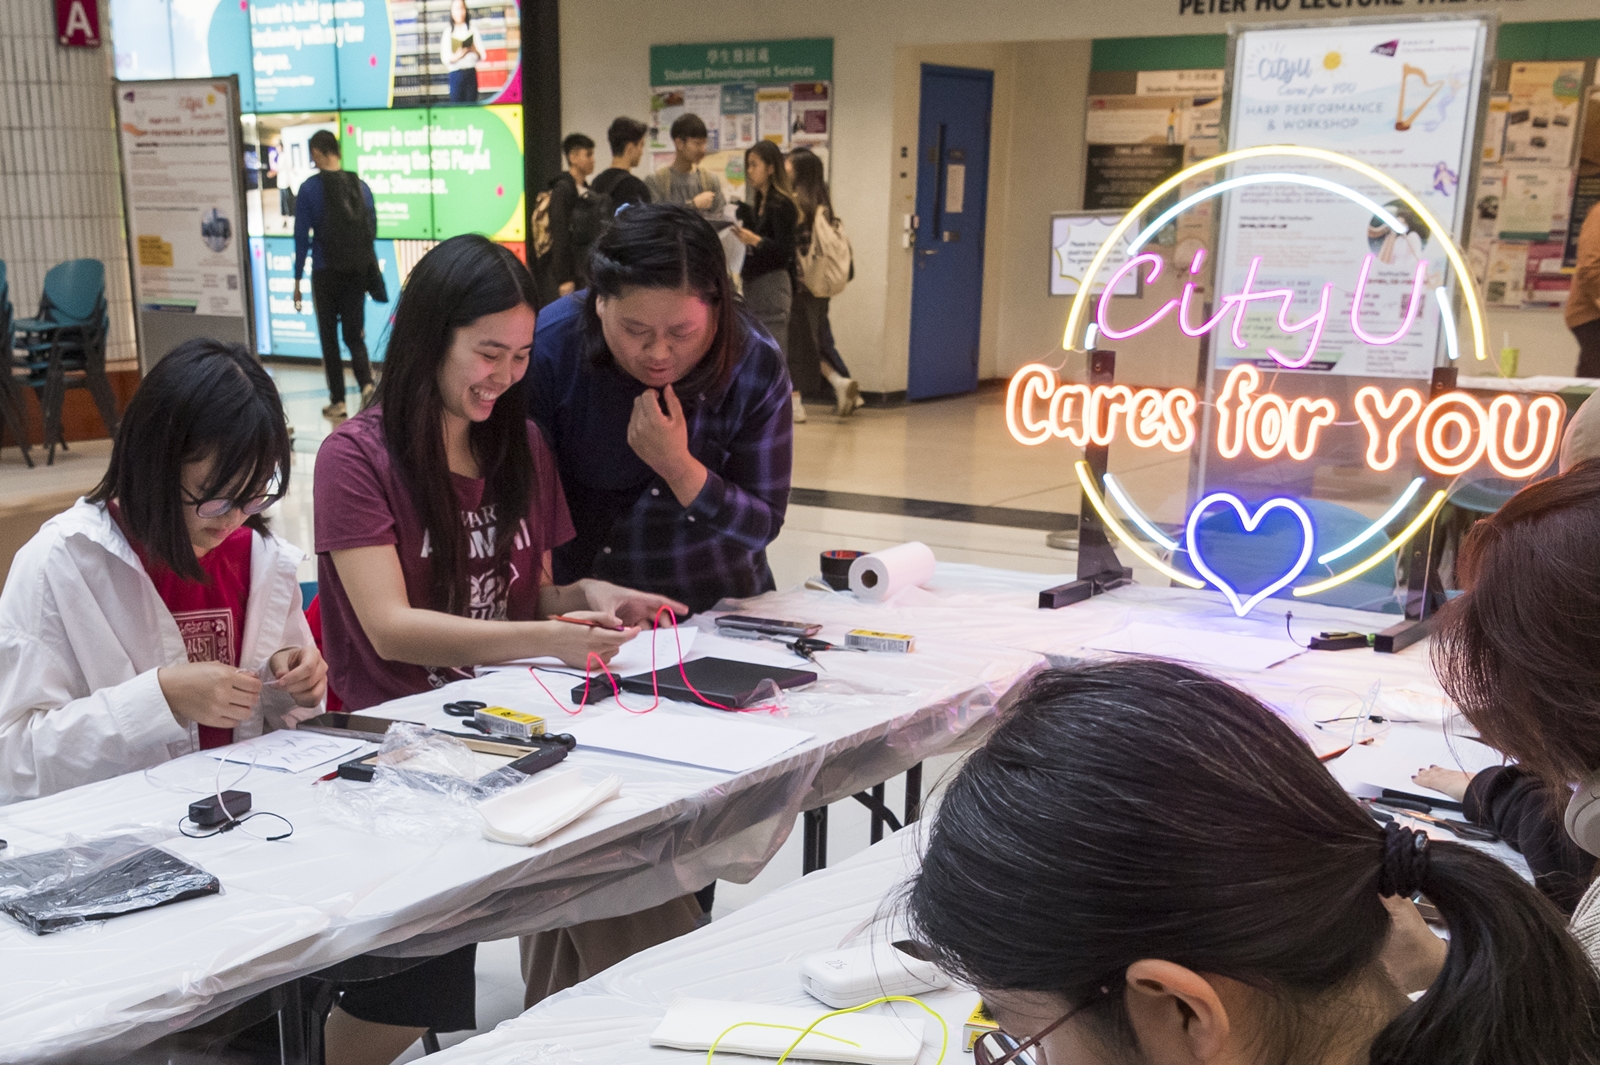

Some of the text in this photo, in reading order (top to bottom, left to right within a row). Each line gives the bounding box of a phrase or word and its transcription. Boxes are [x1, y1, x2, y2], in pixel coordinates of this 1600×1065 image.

[66, 1, 93, 38] A
[704, 65, 771, 80] Development
[773, 64, 815, 78] Services
[1285, 101, 1384, 116] PERFORMANCE
[1283, 117, 1360, 131] WORKSHOP
[1006, 362, 1564, 478] Cares for YOU
